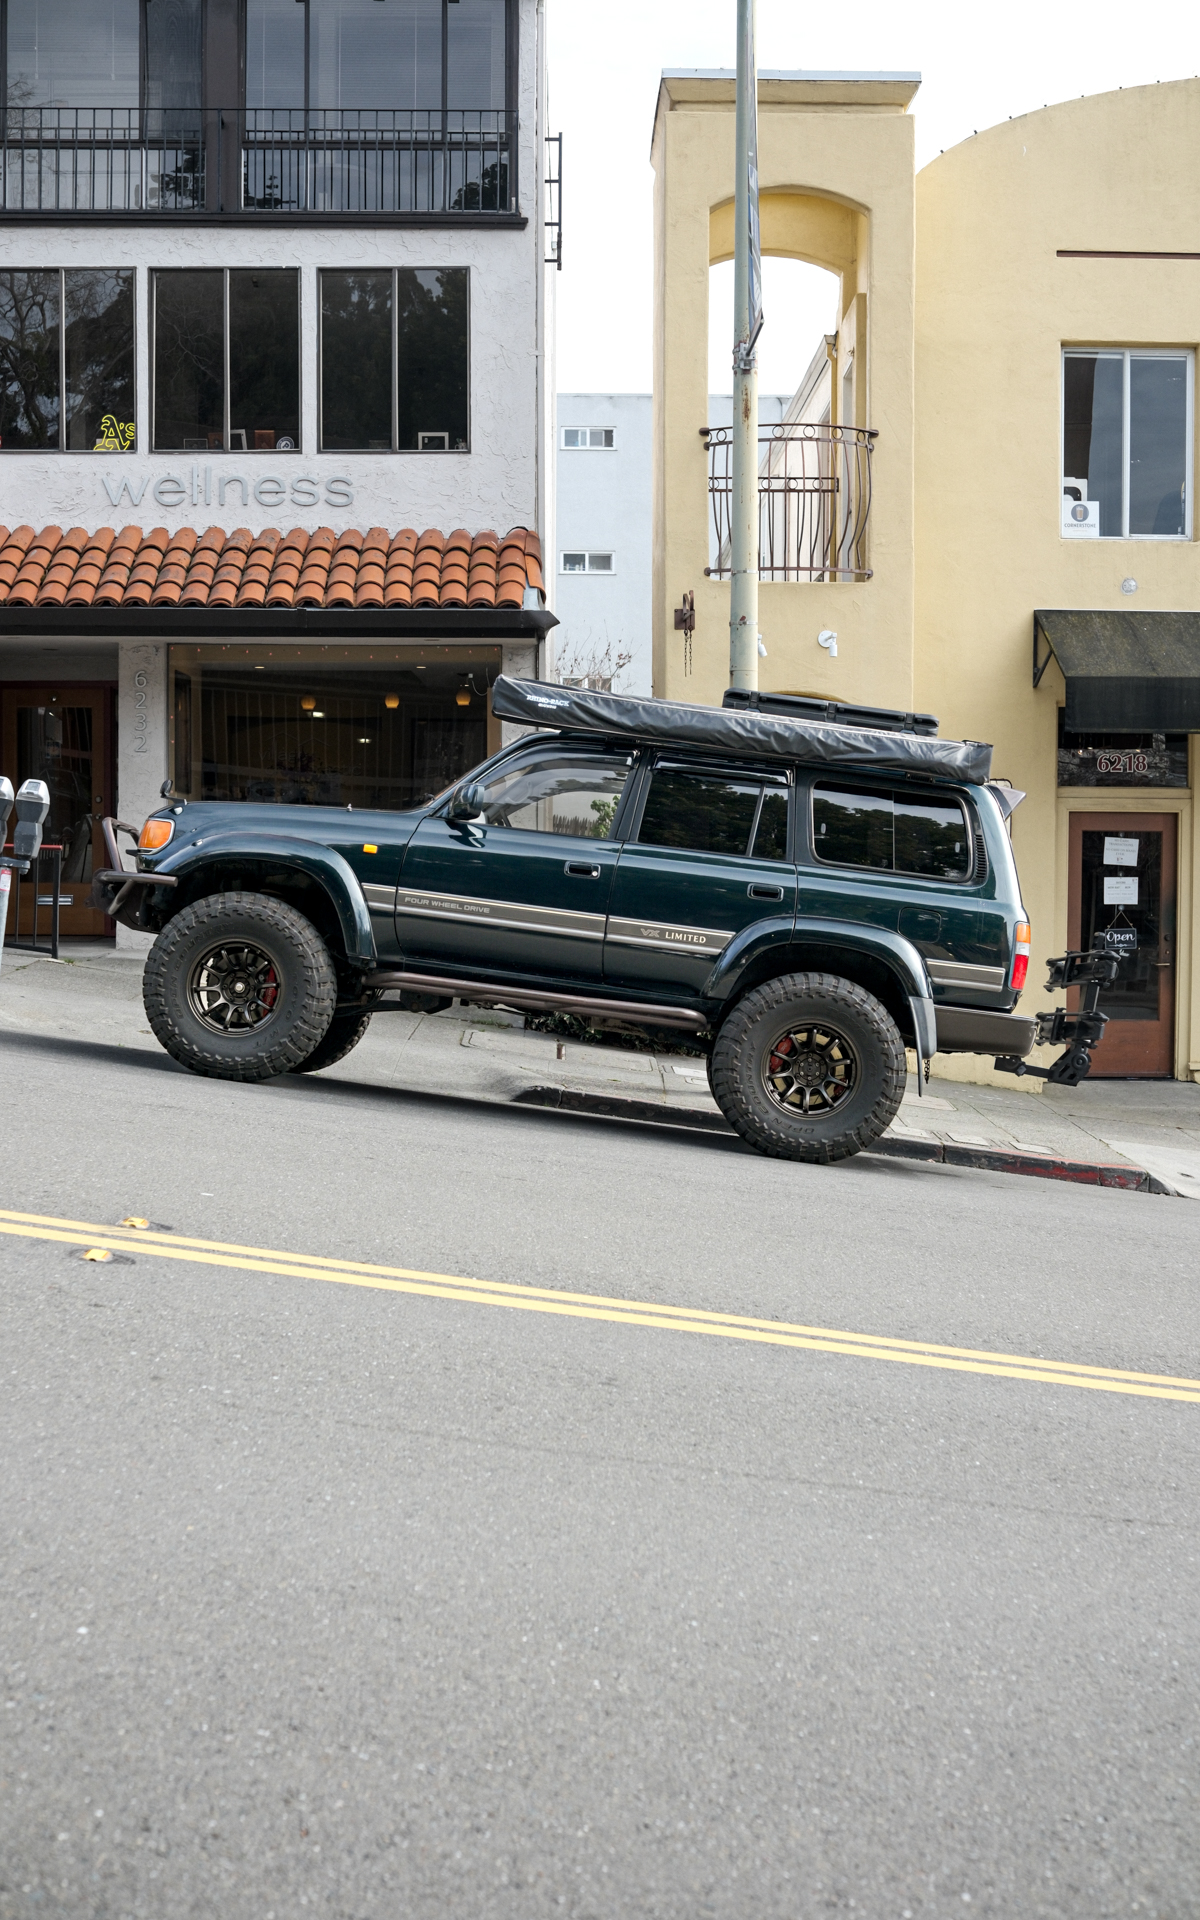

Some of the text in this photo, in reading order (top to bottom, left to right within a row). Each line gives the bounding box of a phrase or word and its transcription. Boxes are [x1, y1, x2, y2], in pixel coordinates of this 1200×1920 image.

[93, 414, 136, 451] A's
[102, 465, 355, 507] wellness
[526, 694, 571, 707] RHINO-RACK
[135, 670, 148, 753] 6232
[1097, 753, 1148, 773] 6218
[405, 896, 491, 914] FOUR WHEEL DRIVE
[640, 928, 707, 944] VX LIMITED
[1106, 931, 1136, 945] Open
[745, 1041, 815, 1135] OPEN COUNTRY
